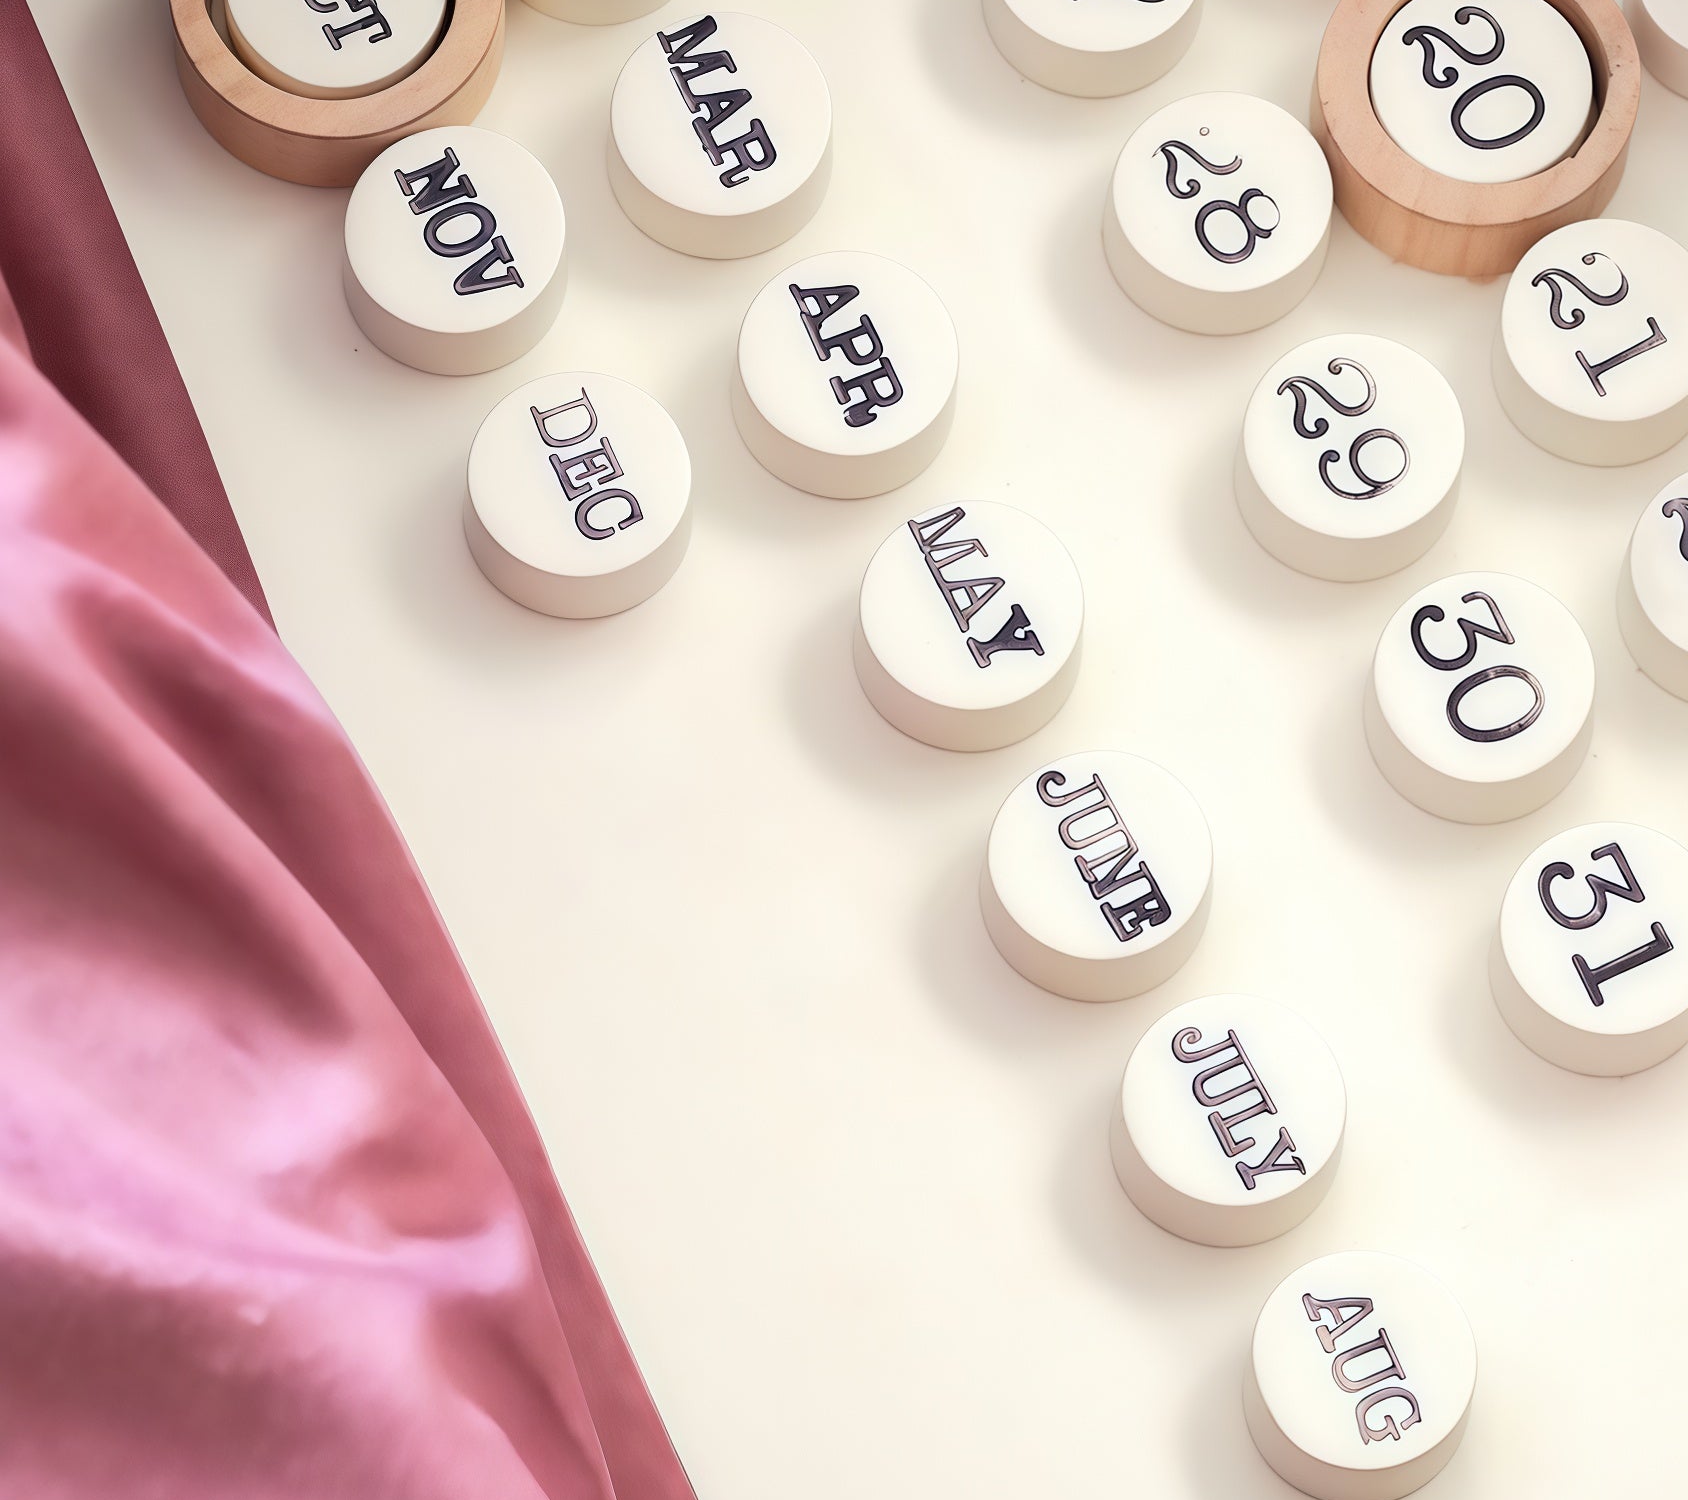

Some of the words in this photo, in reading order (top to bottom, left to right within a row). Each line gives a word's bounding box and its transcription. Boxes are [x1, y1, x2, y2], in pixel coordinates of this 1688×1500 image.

[656, 15, 777, 188] MAR
[1402, 6, 1545, 150] 20
[394, 147, 524, 296] NOV
[1152, 127, 1280, 264] 28
[789, 284, 903, 428] APR
[1531, 252, 1667, 397] 21
[530, 387, 644, 540] DEC
[1277, 358, 1408, 500] 29
[907, 507, 1045, 669] MAY
[1410, 591, 1545, 743] 30
[1036, 770, 1172, 942] JUNE
[1538, 842, 1674, 1007] 31
[1171, 1027, 1306, 1191] JULY
[1302, 1293, 1422, 1445] AUG
